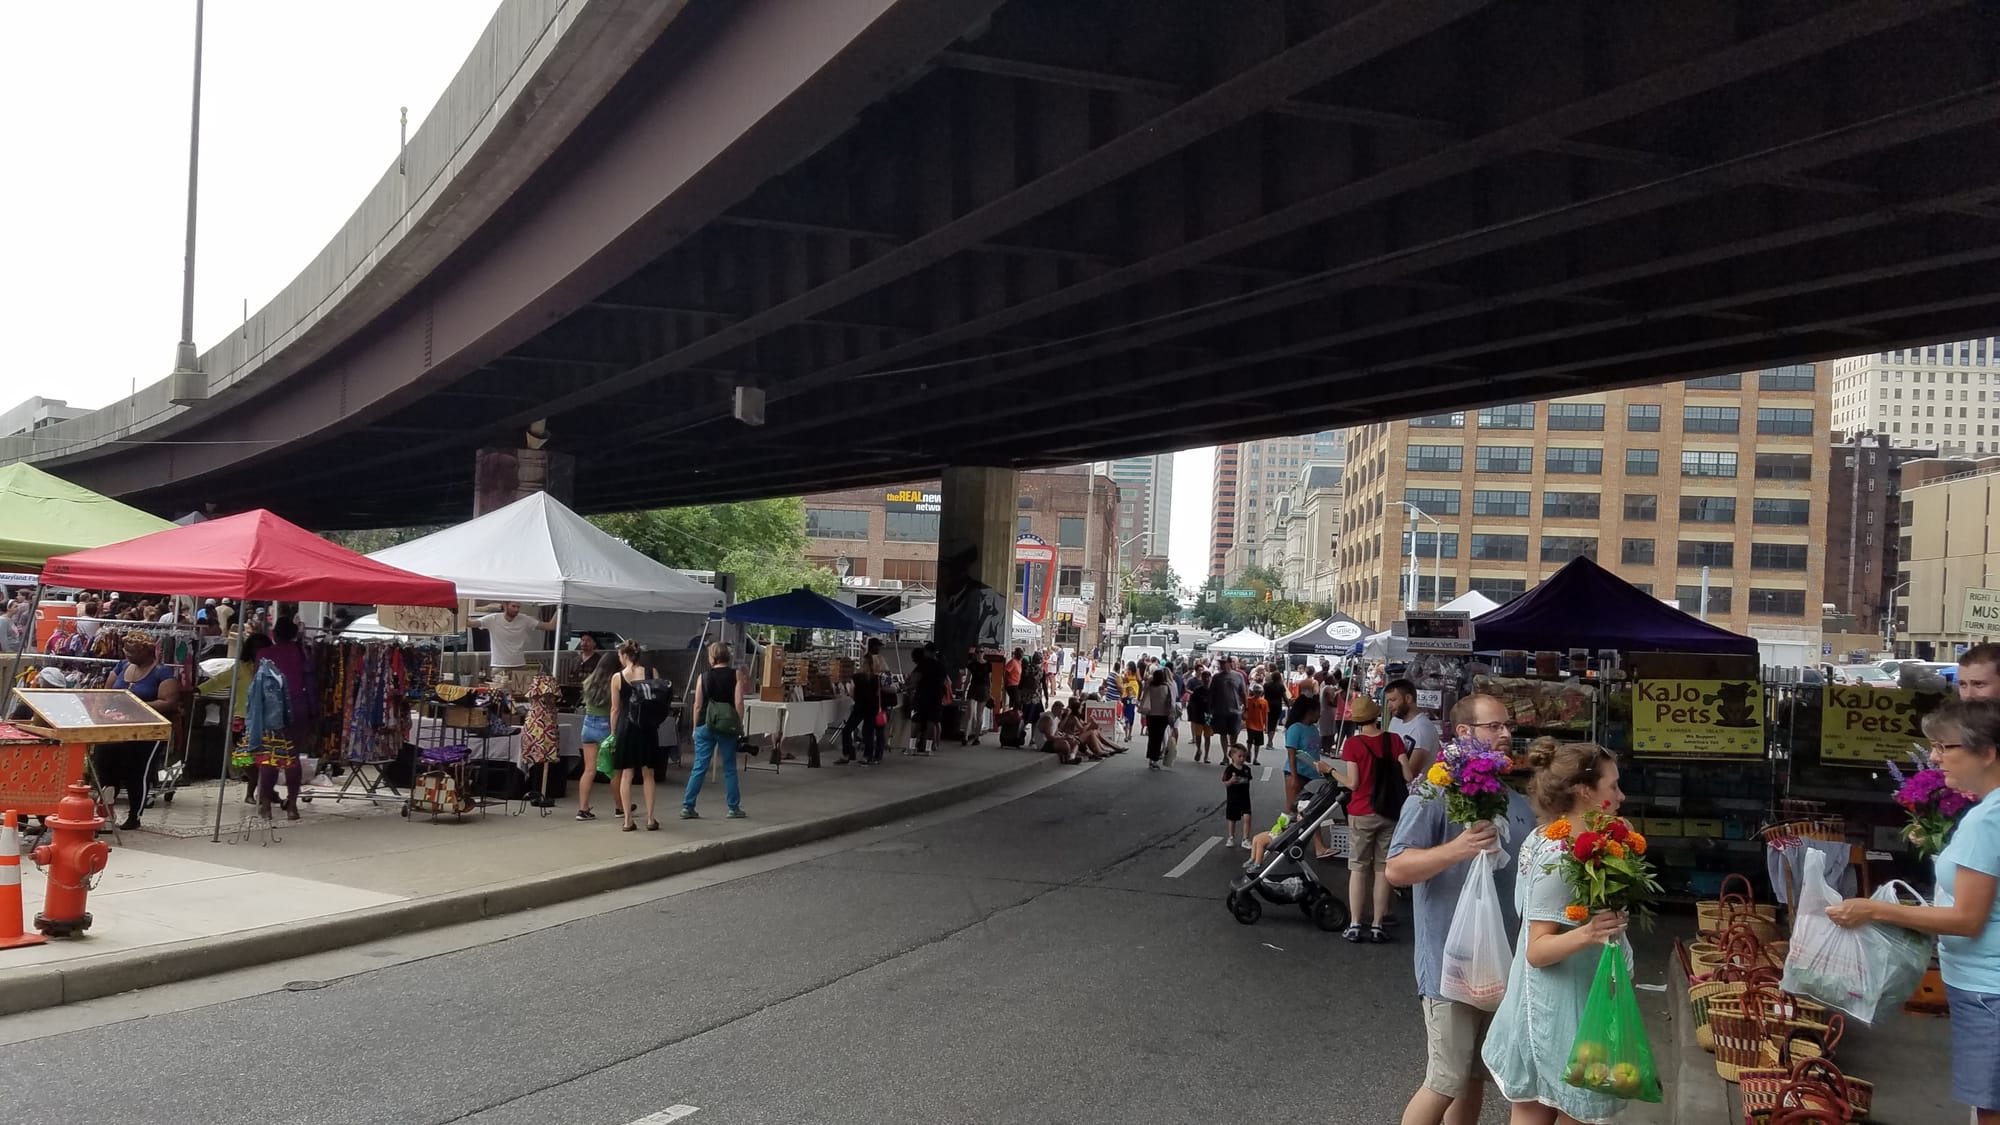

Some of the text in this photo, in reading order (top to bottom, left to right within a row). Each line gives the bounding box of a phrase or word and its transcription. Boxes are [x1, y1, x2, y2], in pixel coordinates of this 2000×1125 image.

[1969, 593, 1991, 601] RIGHT
[1965, 621, 1985, 630] TURN
[1454, 641, 1470, 649] Dogs
[1638, 682, 1701, 703] KaJo
[1829, 688, 1894, 710] KaJo
[1091, 709, 1112, 718] ATM
[1656, 704, 1711, 724] Pets
[1846, 711, 1902, 733] Pets
